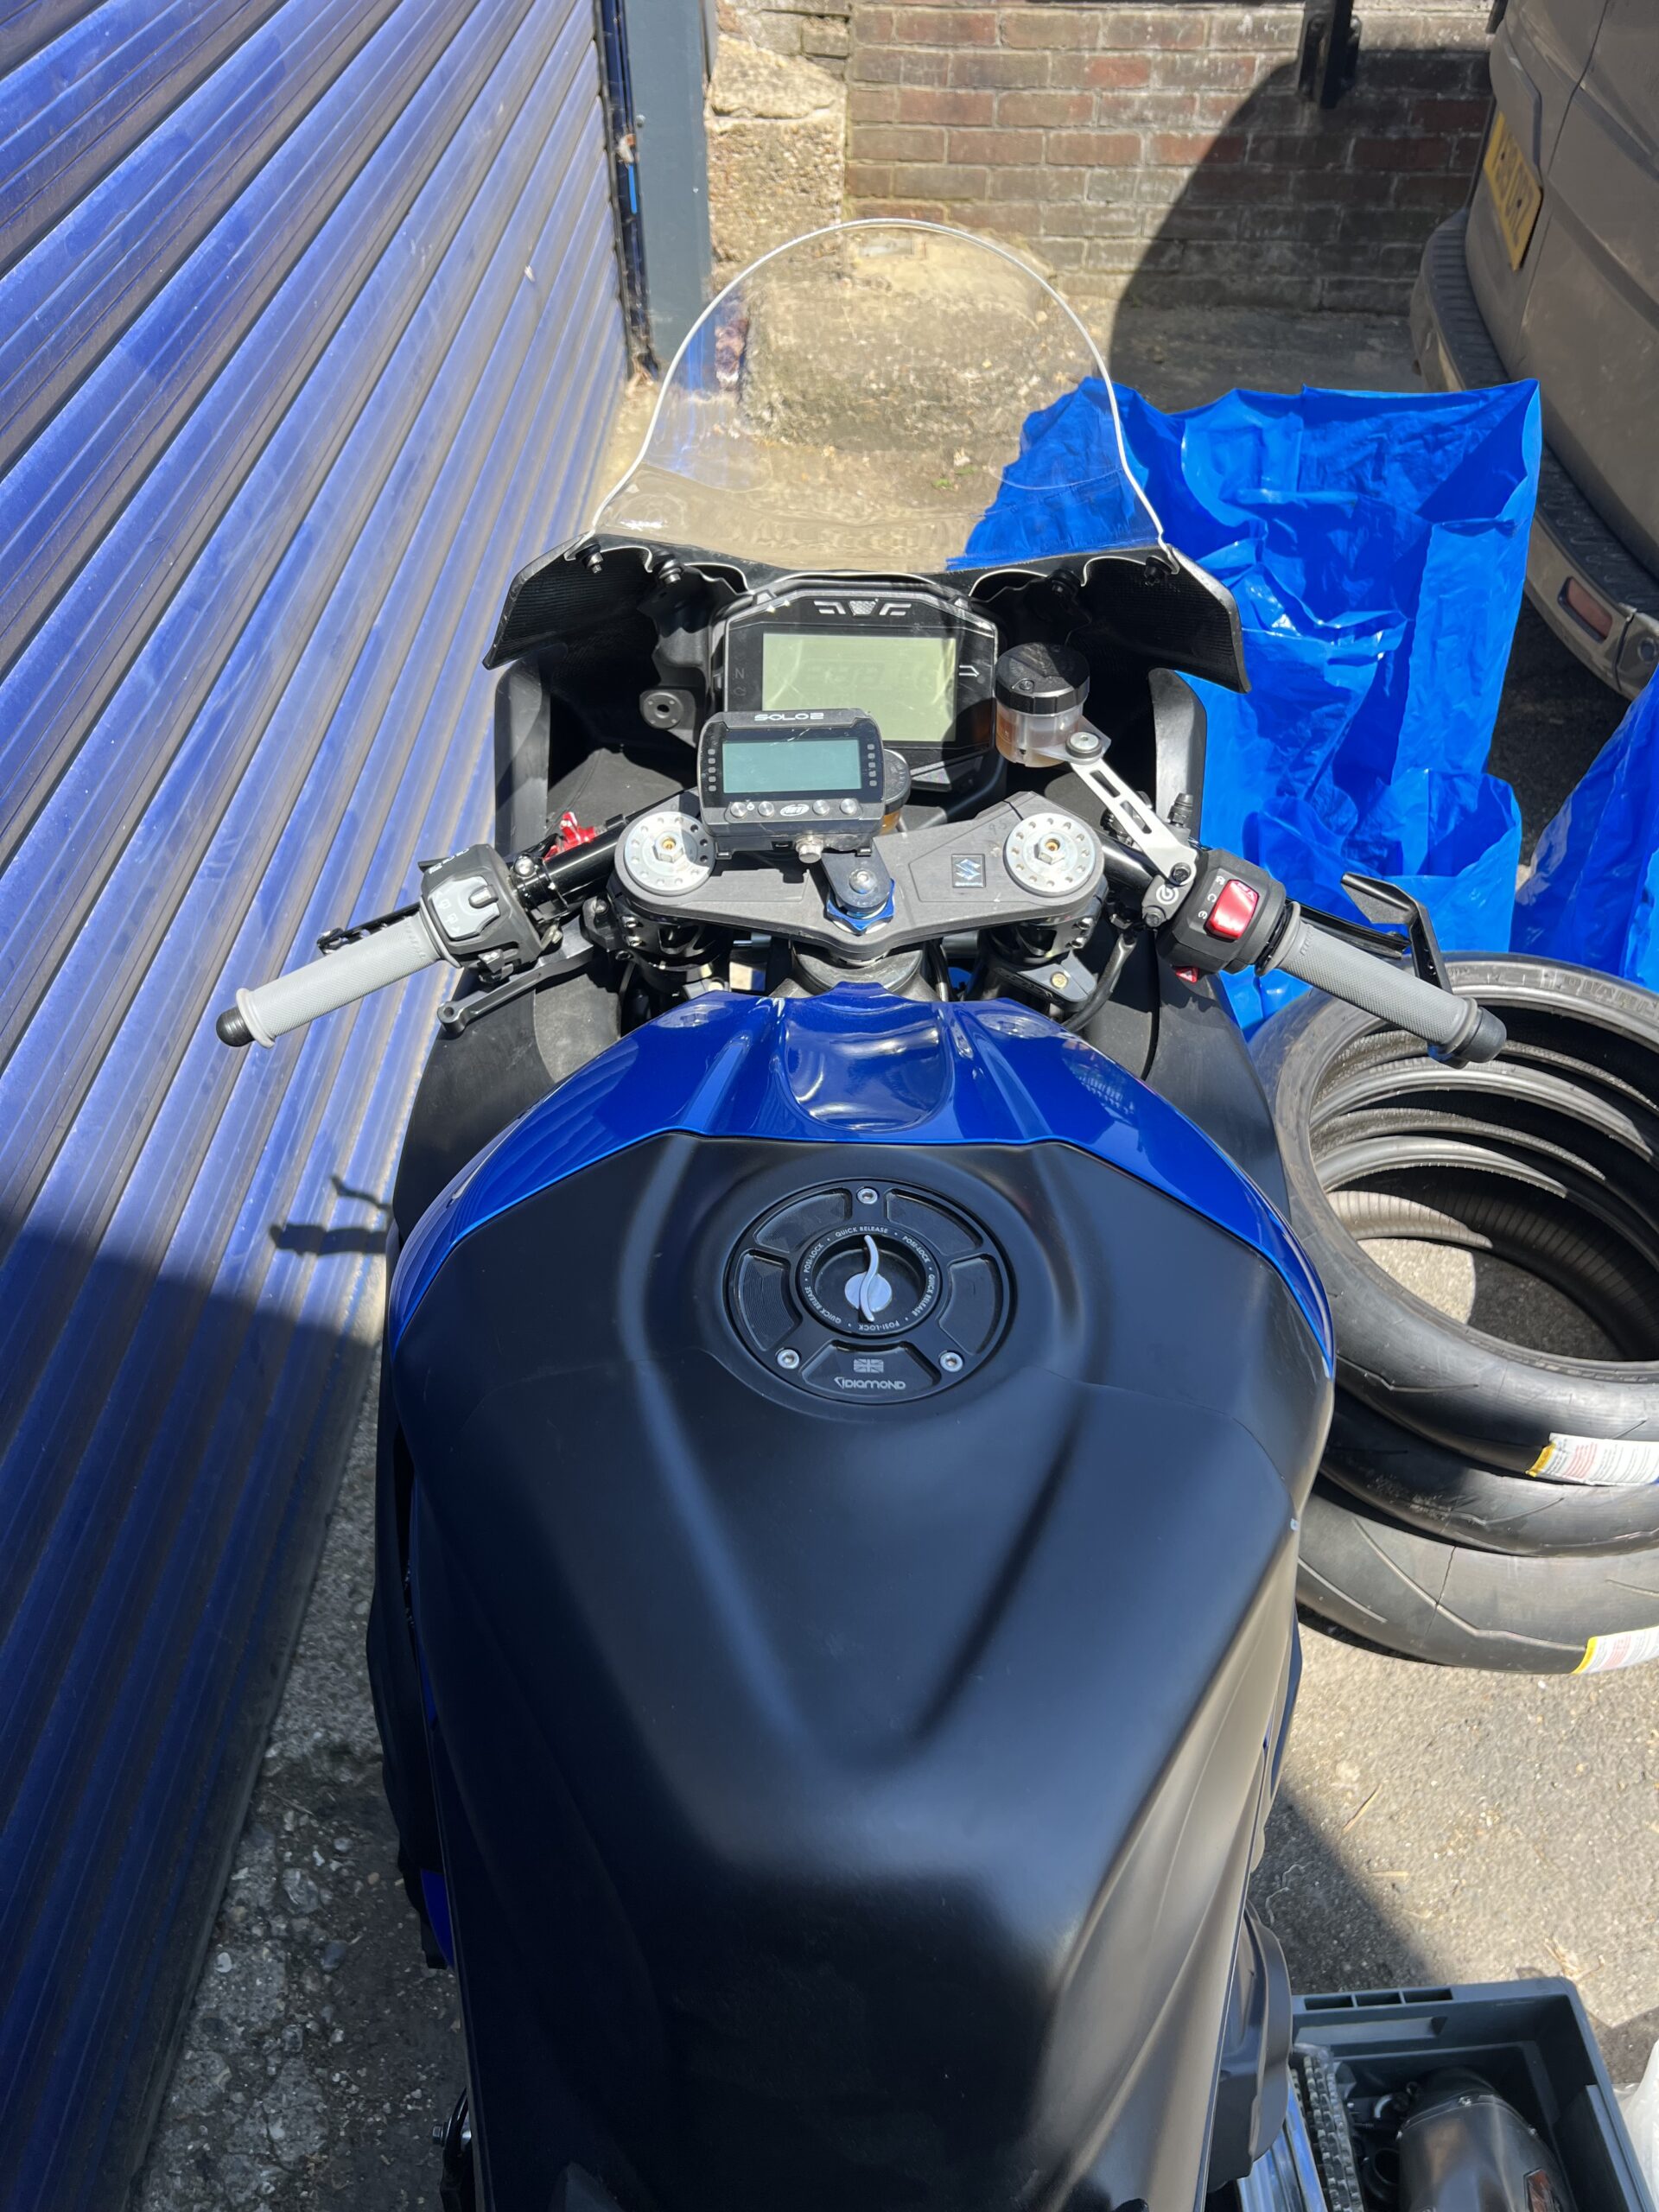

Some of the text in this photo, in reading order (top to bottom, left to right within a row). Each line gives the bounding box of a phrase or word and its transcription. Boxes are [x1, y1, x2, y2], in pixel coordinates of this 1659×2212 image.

[835, 1227, 858, 1237] QUICK
[804, 1243, 824, 1274] POSI-LOCK
[902, 1236, 931, 1263] POSI-LOCK
[804, 1286, 842, 1325] QUICK RELEASE
[912, 1274, 936, 1317] QUICK RELEASE
[858, 1320, 900, 1332] POSI-LOCK
